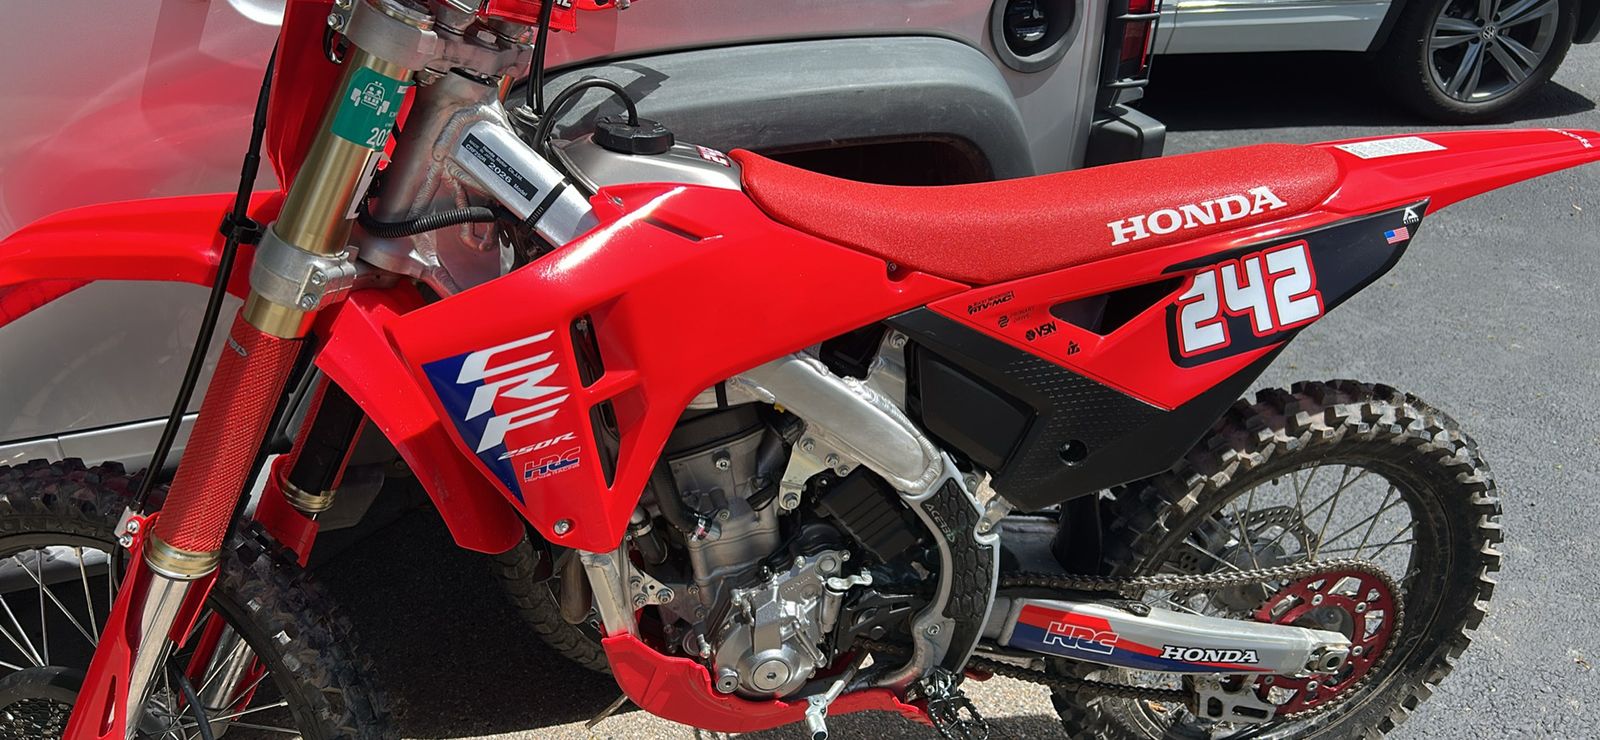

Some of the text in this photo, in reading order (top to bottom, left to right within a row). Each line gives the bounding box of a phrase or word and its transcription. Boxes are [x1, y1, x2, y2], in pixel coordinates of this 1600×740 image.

[465, 144, 528, 197] CRF250R 2026 Model
[482, 146, 496, 158] Honda
[496, 157, 508, 168] Motor
[1107, 185, 1287, 246] HONDA
[1176, 242, 1323, 355] 242
[1034, 321, 1057, 337] VSN
[455, 329, 570, 454] CRF
[497, 431, 577, 461] 250R
[523, 445, 581, 481] HRC
[1042, 621, 1119, 655] HRC
[1159, 644, 1259, 664] HONDA
